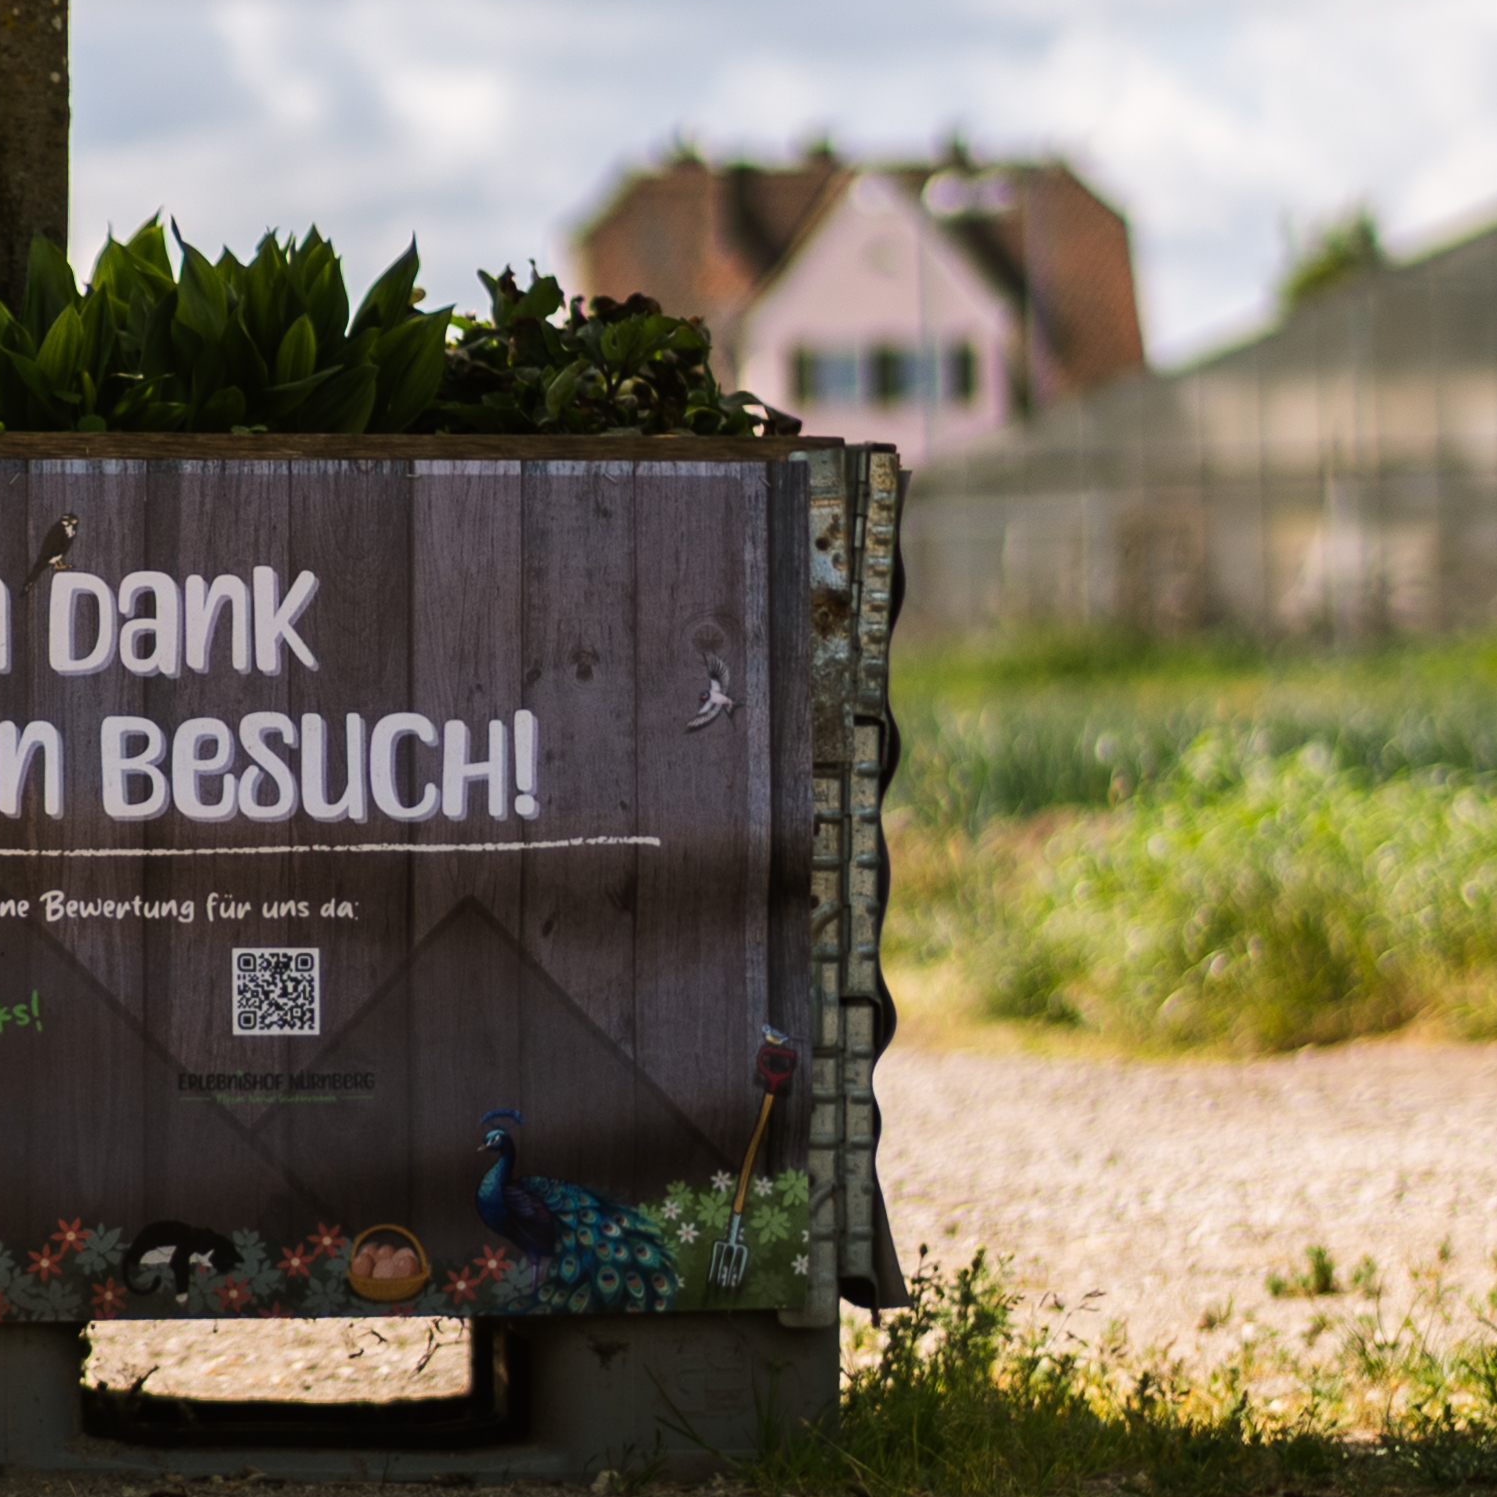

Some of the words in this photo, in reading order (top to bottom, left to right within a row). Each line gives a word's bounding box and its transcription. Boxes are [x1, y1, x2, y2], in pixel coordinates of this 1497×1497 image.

[39, 890, 194, 923] Bewertung
[206, 892, 251, 921] für
[262, 898, 310, 919] uns
